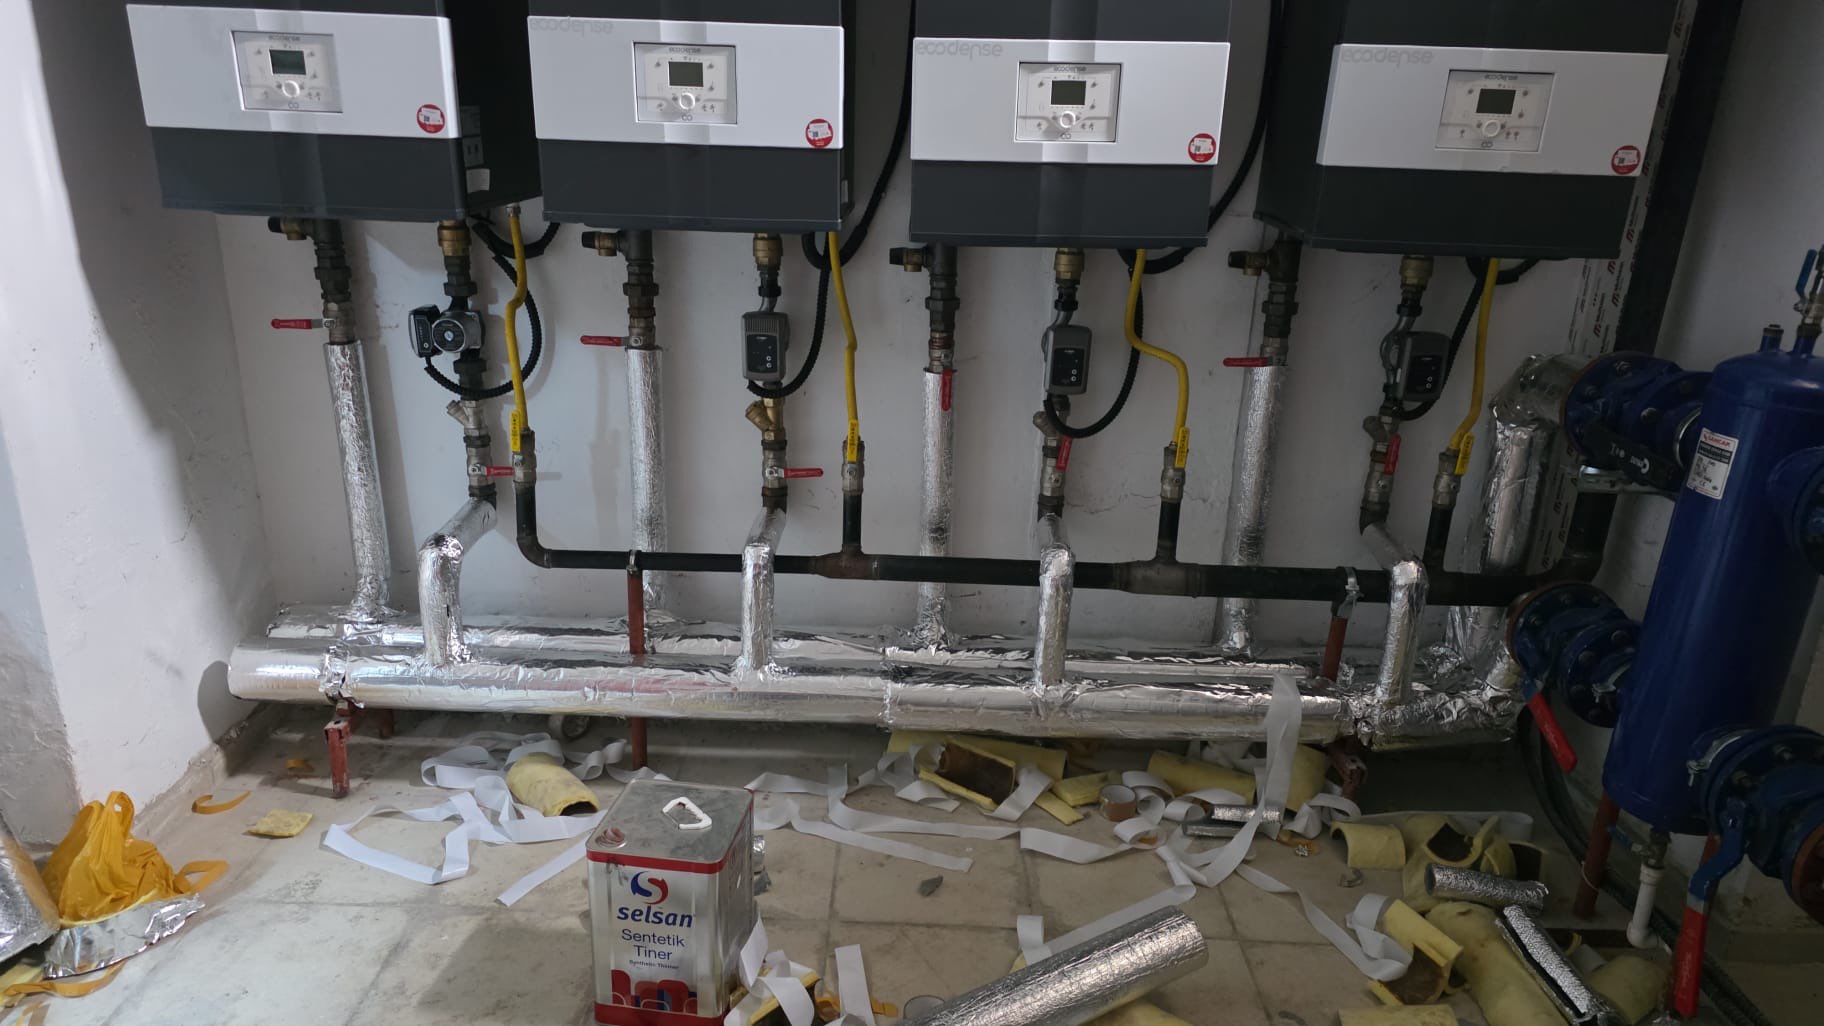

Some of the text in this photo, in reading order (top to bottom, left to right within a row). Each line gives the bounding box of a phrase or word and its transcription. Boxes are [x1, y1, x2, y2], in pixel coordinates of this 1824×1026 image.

[916, 40, 1003, 61] ecodense
[1342, 48, 1433, 69] ecodense
[617, 905, 693, 928] selsan
[621, 928, 685, 947] Sentetik
[633, 945, 672, 960] Tiner
